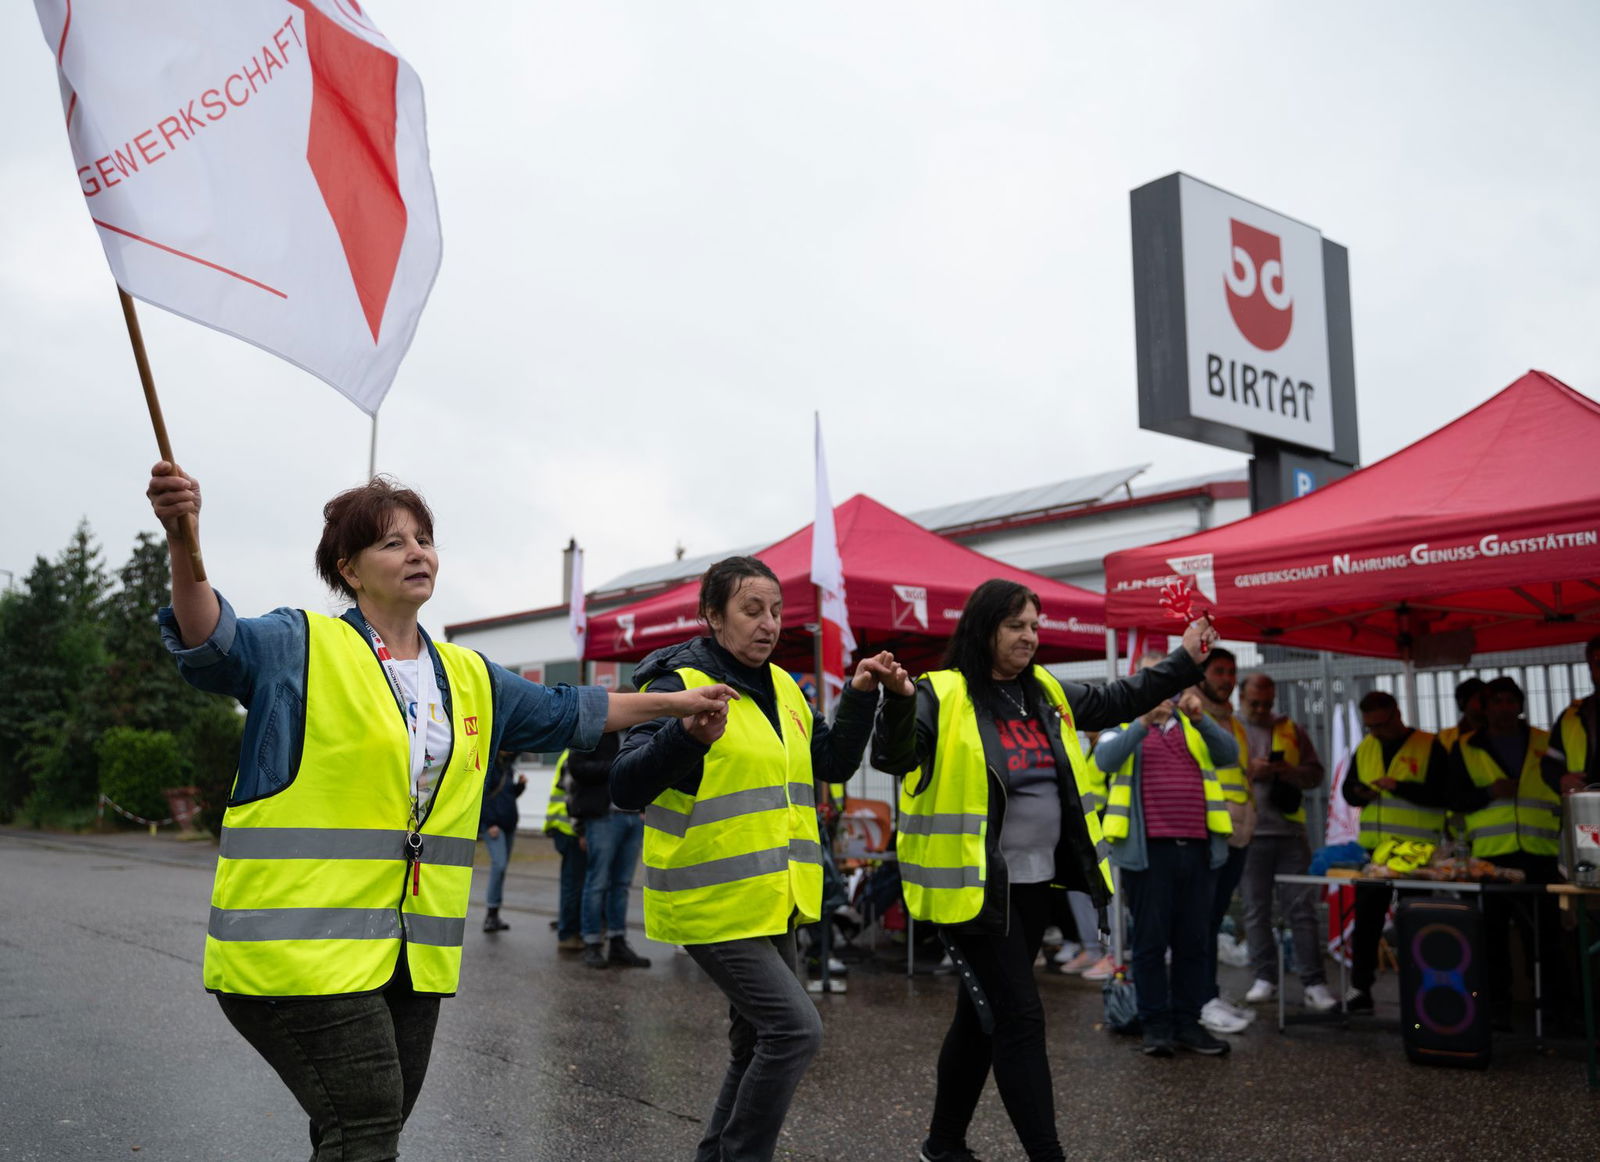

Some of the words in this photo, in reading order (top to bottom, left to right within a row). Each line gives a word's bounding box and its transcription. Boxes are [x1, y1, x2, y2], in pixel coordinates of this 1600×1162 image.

[77, 16, 303, 197] GEWERKSCHAFT
[1207, 353, 1314, 422] BIRTAT
[1297, 471, 1312, 497] P
[1234, 564, 1329, 588] GEWERKSCHAFT
